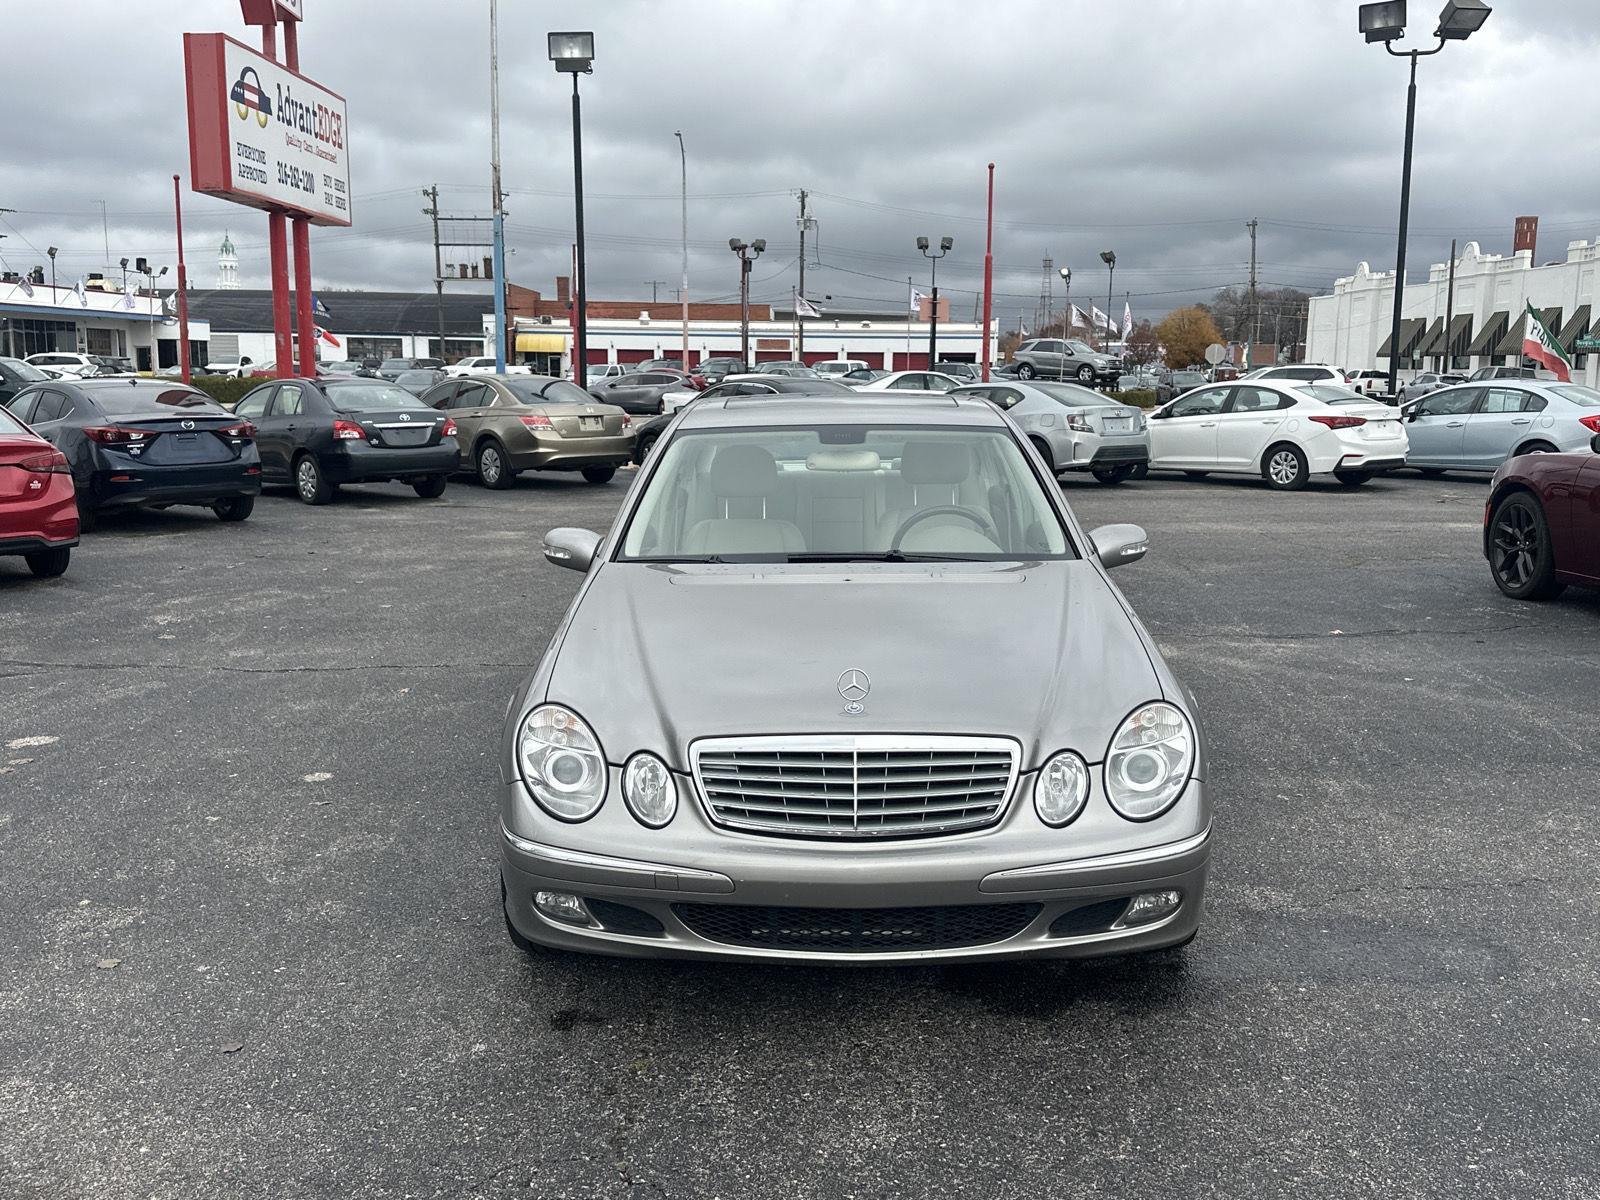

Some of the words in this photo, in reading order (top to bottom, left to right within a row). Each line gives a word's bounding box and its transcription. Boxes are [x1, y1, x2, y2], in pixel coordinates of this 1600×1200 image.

[277, 83, 342, 150] AdvantEDGE
[237, 142, 266, 165] EVERYONE
[286, 132, 303, 153] Quality
[238, 162, 267, 184] APPROVED
[277, 161, 315, 195] 316-262-1200
[323, 174, 333, 189] BUY
[334, 179, 346, 193] HERE
[324, 192, 333, 206] PAY
[335, 196, 347, 210] HERE
